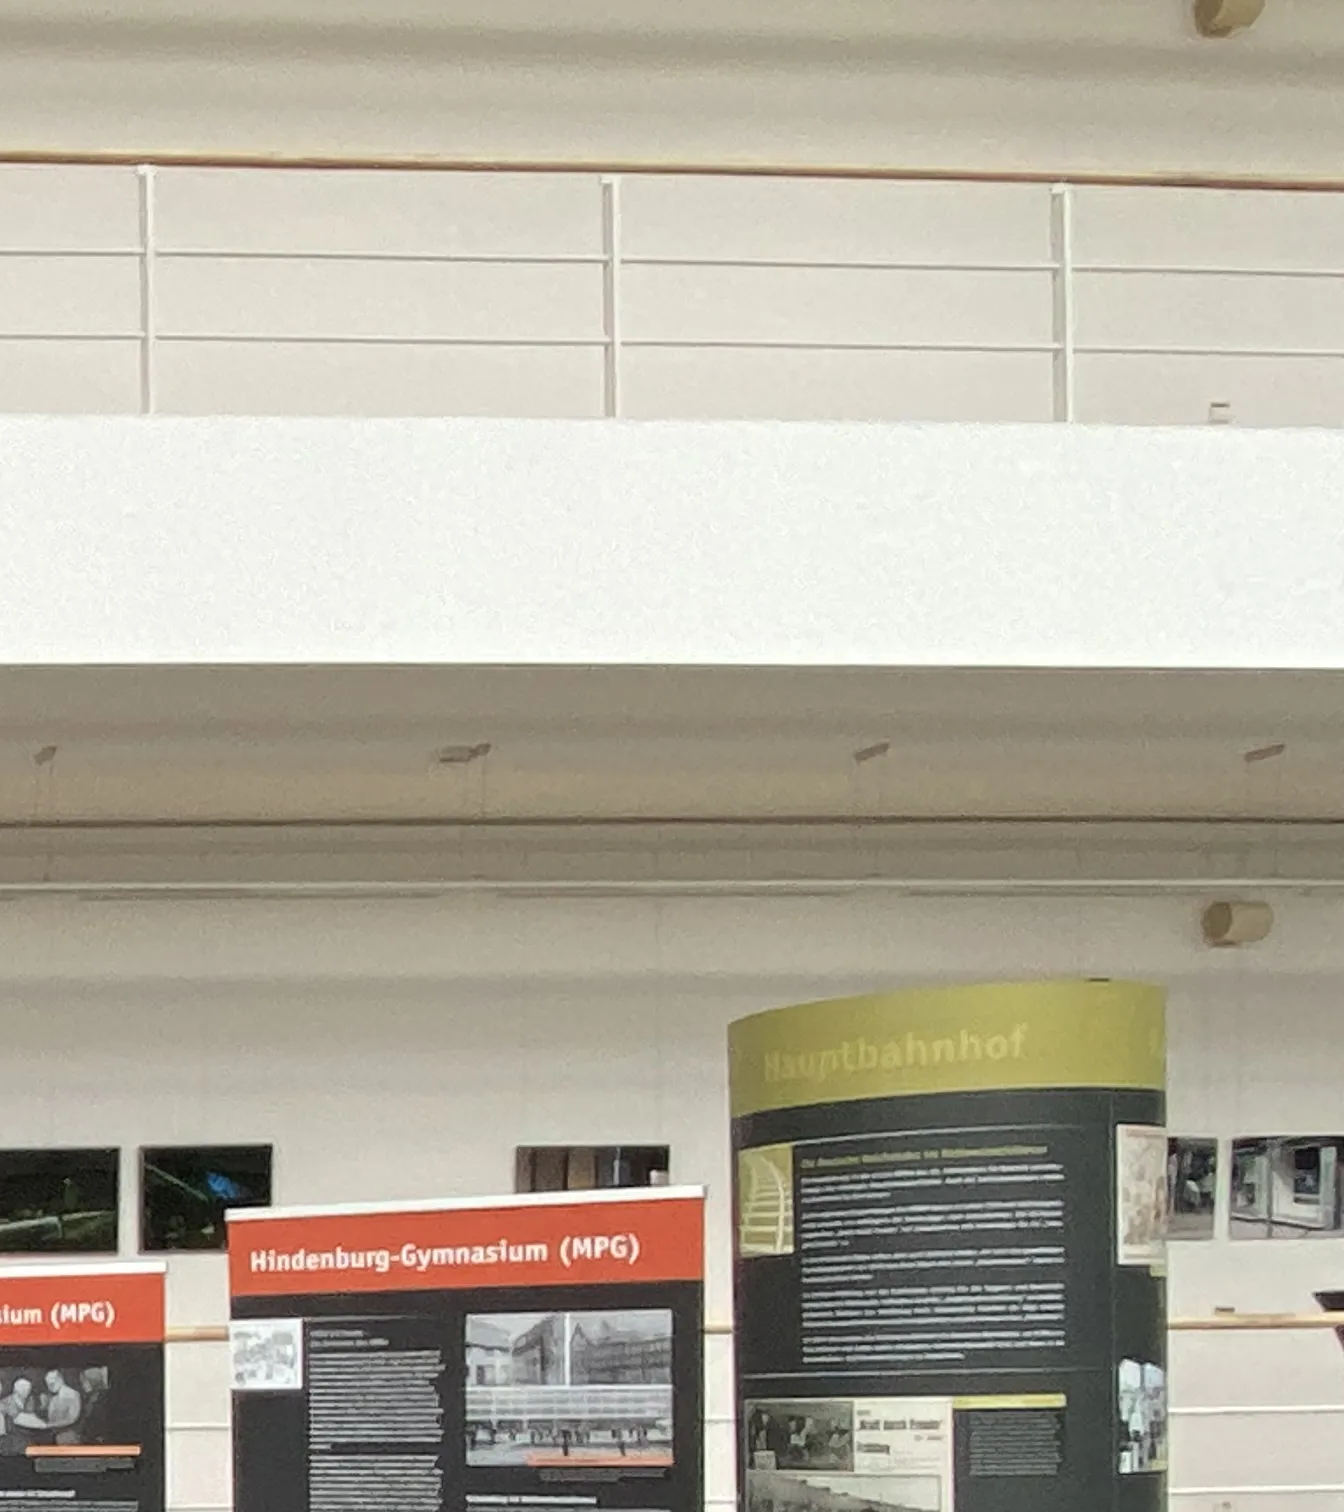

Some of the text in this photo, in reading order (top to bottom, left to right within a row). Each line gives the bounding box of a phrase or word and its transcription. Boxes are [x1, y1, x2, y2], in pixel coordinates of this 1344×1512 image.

[250, 1232, 641, 1273] Hindenburg-Gymnasium (MPG)
[50, 1300, 115, 1330] (MPG)
